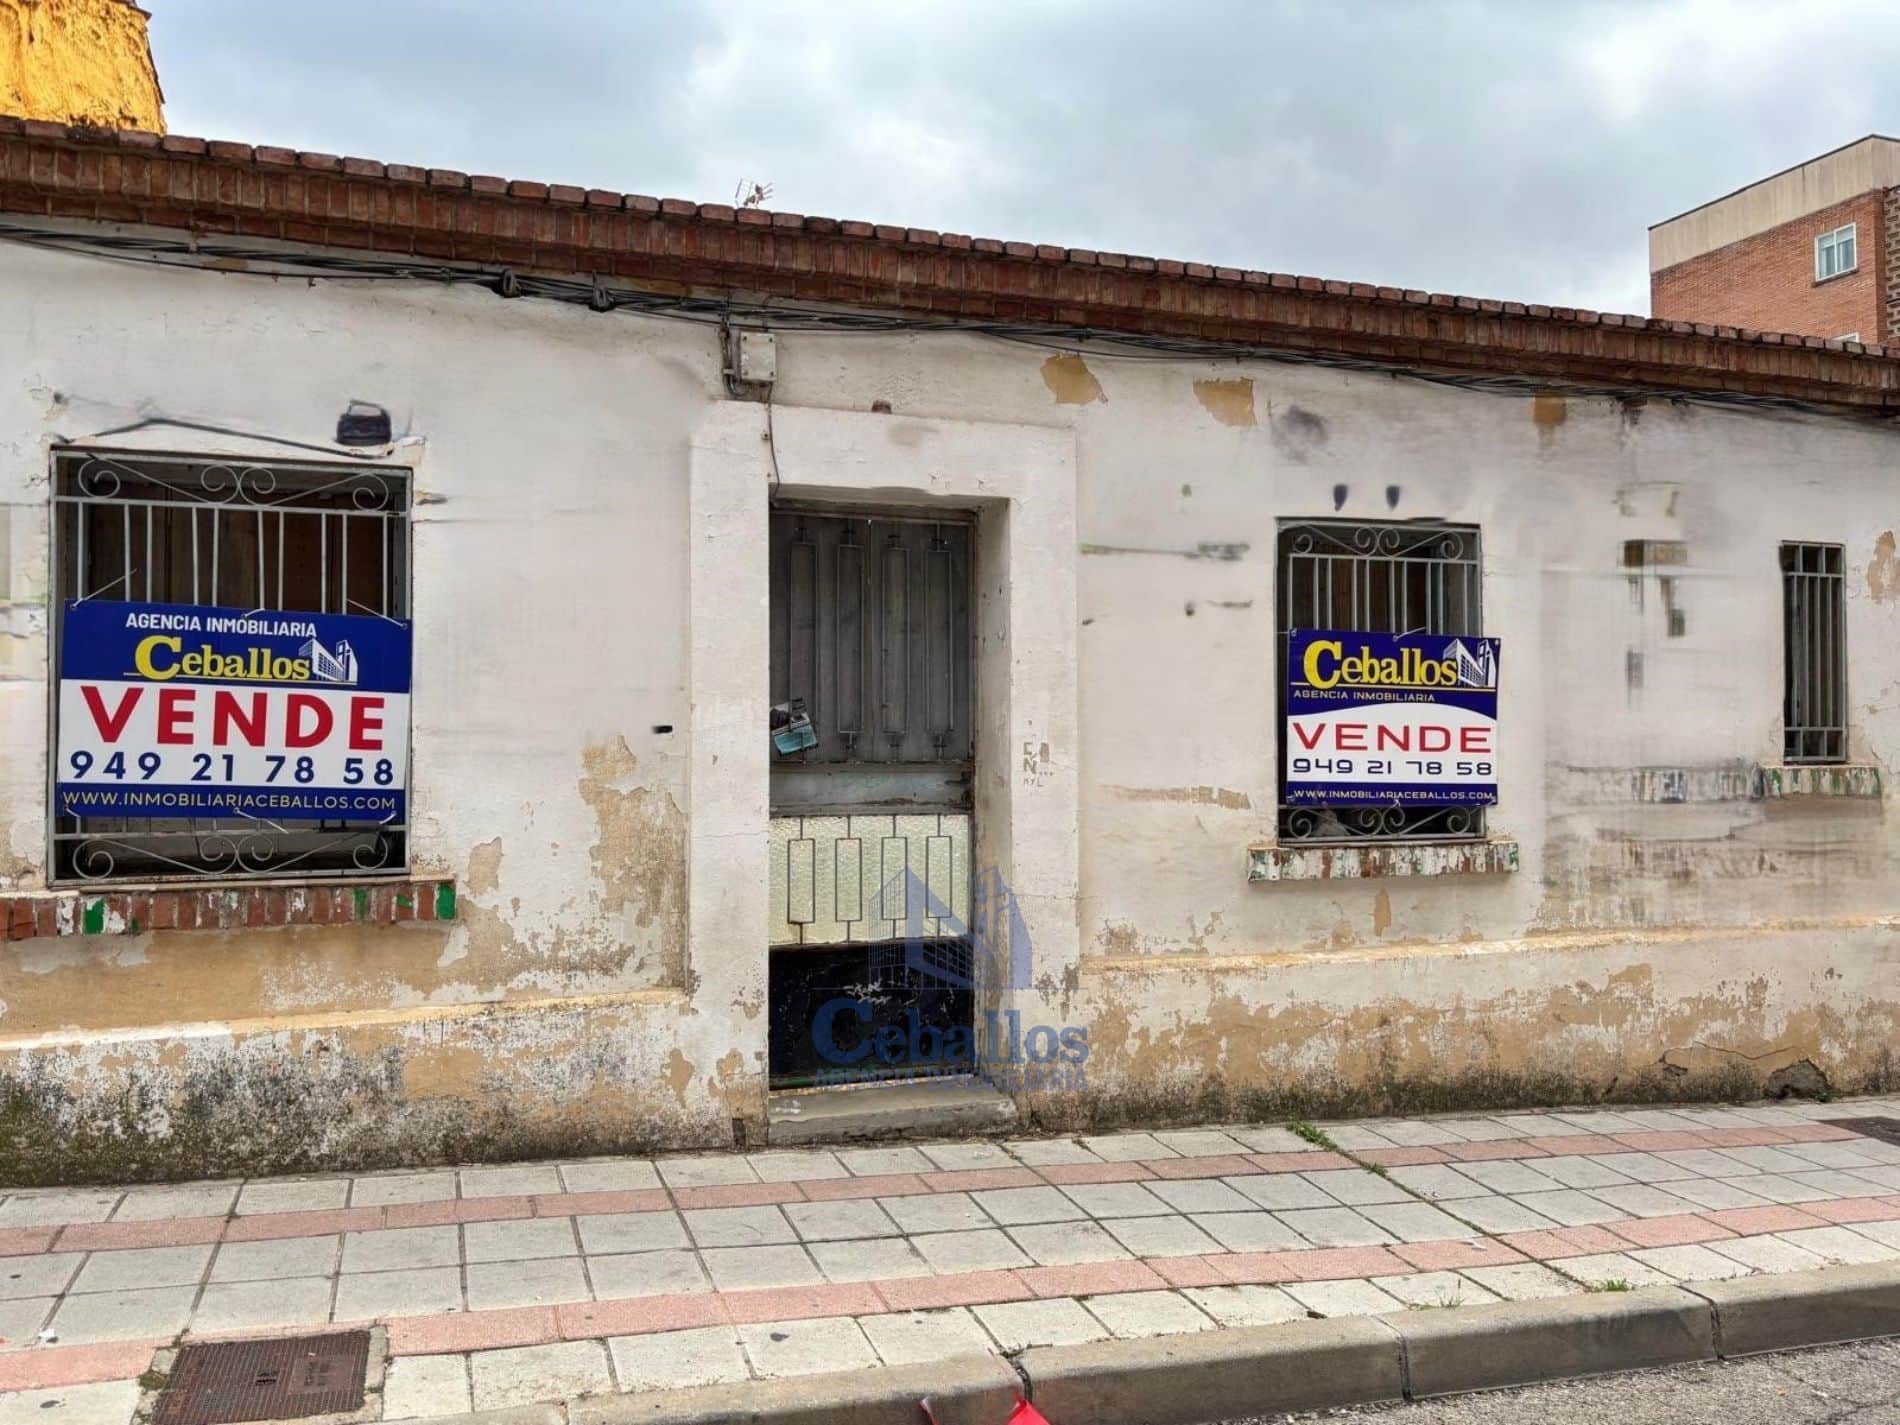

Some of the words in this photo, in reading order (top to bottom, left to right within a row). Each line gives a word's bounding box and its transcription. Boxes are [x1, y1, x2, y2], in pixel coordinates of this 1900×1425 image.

[126, 612, 201, 632] AGENCIA
[206, 617, 317, 637] INMOBILIARIA
[135, 635, 310, 681] Ceballos
[1303, 640, 1458, 689] Ceballos
[1293, 689, 1349, 700] AGENCIA
[1353, 691, 1436, 702] INMOBILIARIA
[81, 685, 385, 751] VENDE
[1293, 722, 1492, 753] VENDE
[70, 750, 161, 780] 949
[191, 753, 235, 782] 21
[265, 755, 315, 783] 78
[343, 758, 394, 786] 58
[1293, 758, 1354, 774] 949
[1367, 760, 1392, 774] 21
[1406, 761, 1442, 775] 78
[1457, 762, 1493, 776] 58
[63, 791, 396, 811] WWW.INMOBILIARIACEBALLOS.COM
[1293, 789, 1493, 800] WWW.INMOBILIARIACEBALLOS.COM
